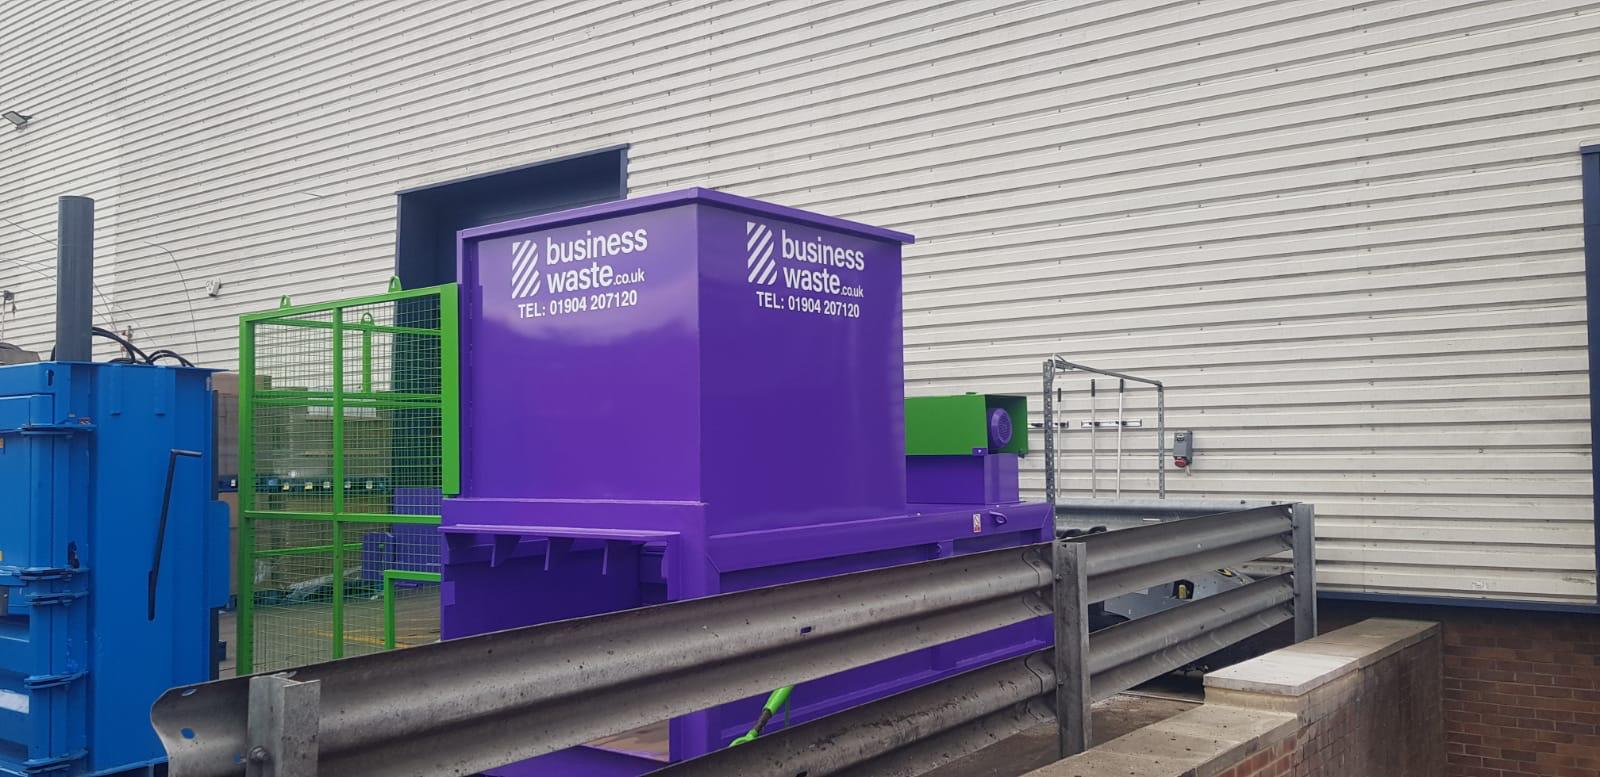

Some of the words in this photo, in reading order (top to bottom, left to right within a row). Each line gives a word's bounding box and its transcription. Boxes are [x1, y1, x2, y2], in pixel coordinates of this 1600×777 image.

[547, 229, 648, 266] business
[782, 229, 865, 271] business
[546, 261, 646, 294] waste.co.uk
[782, 266, 865, 298] waste.co.uk
[517, 302, 546, 319] TEL:
[549, 294, 587, 316] 01904
[590, 289, 638, 310] 207120
[756, 291, 785, 310] TEL:
[787, 295, 822, 313] 01904
[823, 300, 860, 318] 207120
